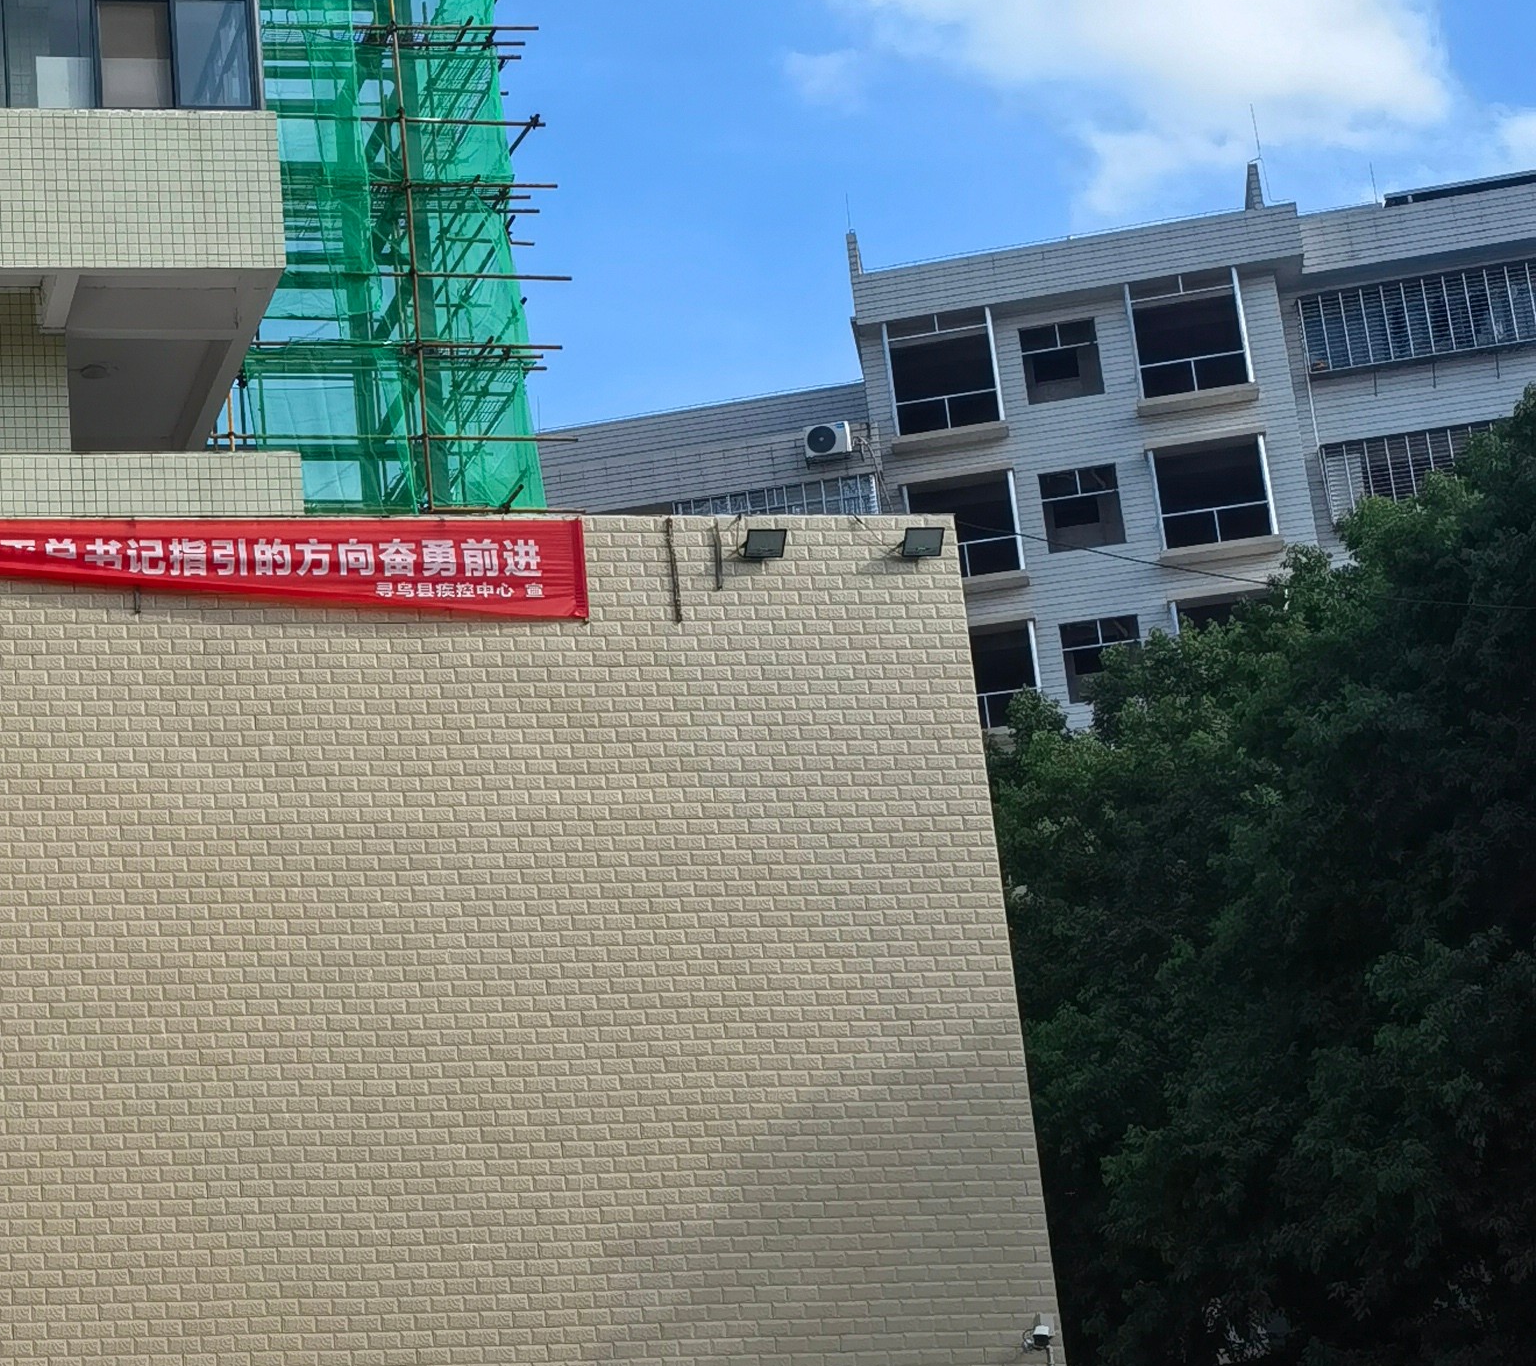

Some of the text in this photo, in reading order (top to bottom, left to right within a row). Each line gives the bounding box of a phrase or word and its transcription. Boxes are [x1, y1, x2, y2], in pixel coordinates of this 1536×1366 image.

[375, 582, 545, 598] 寻乌县疾控中心 宣
